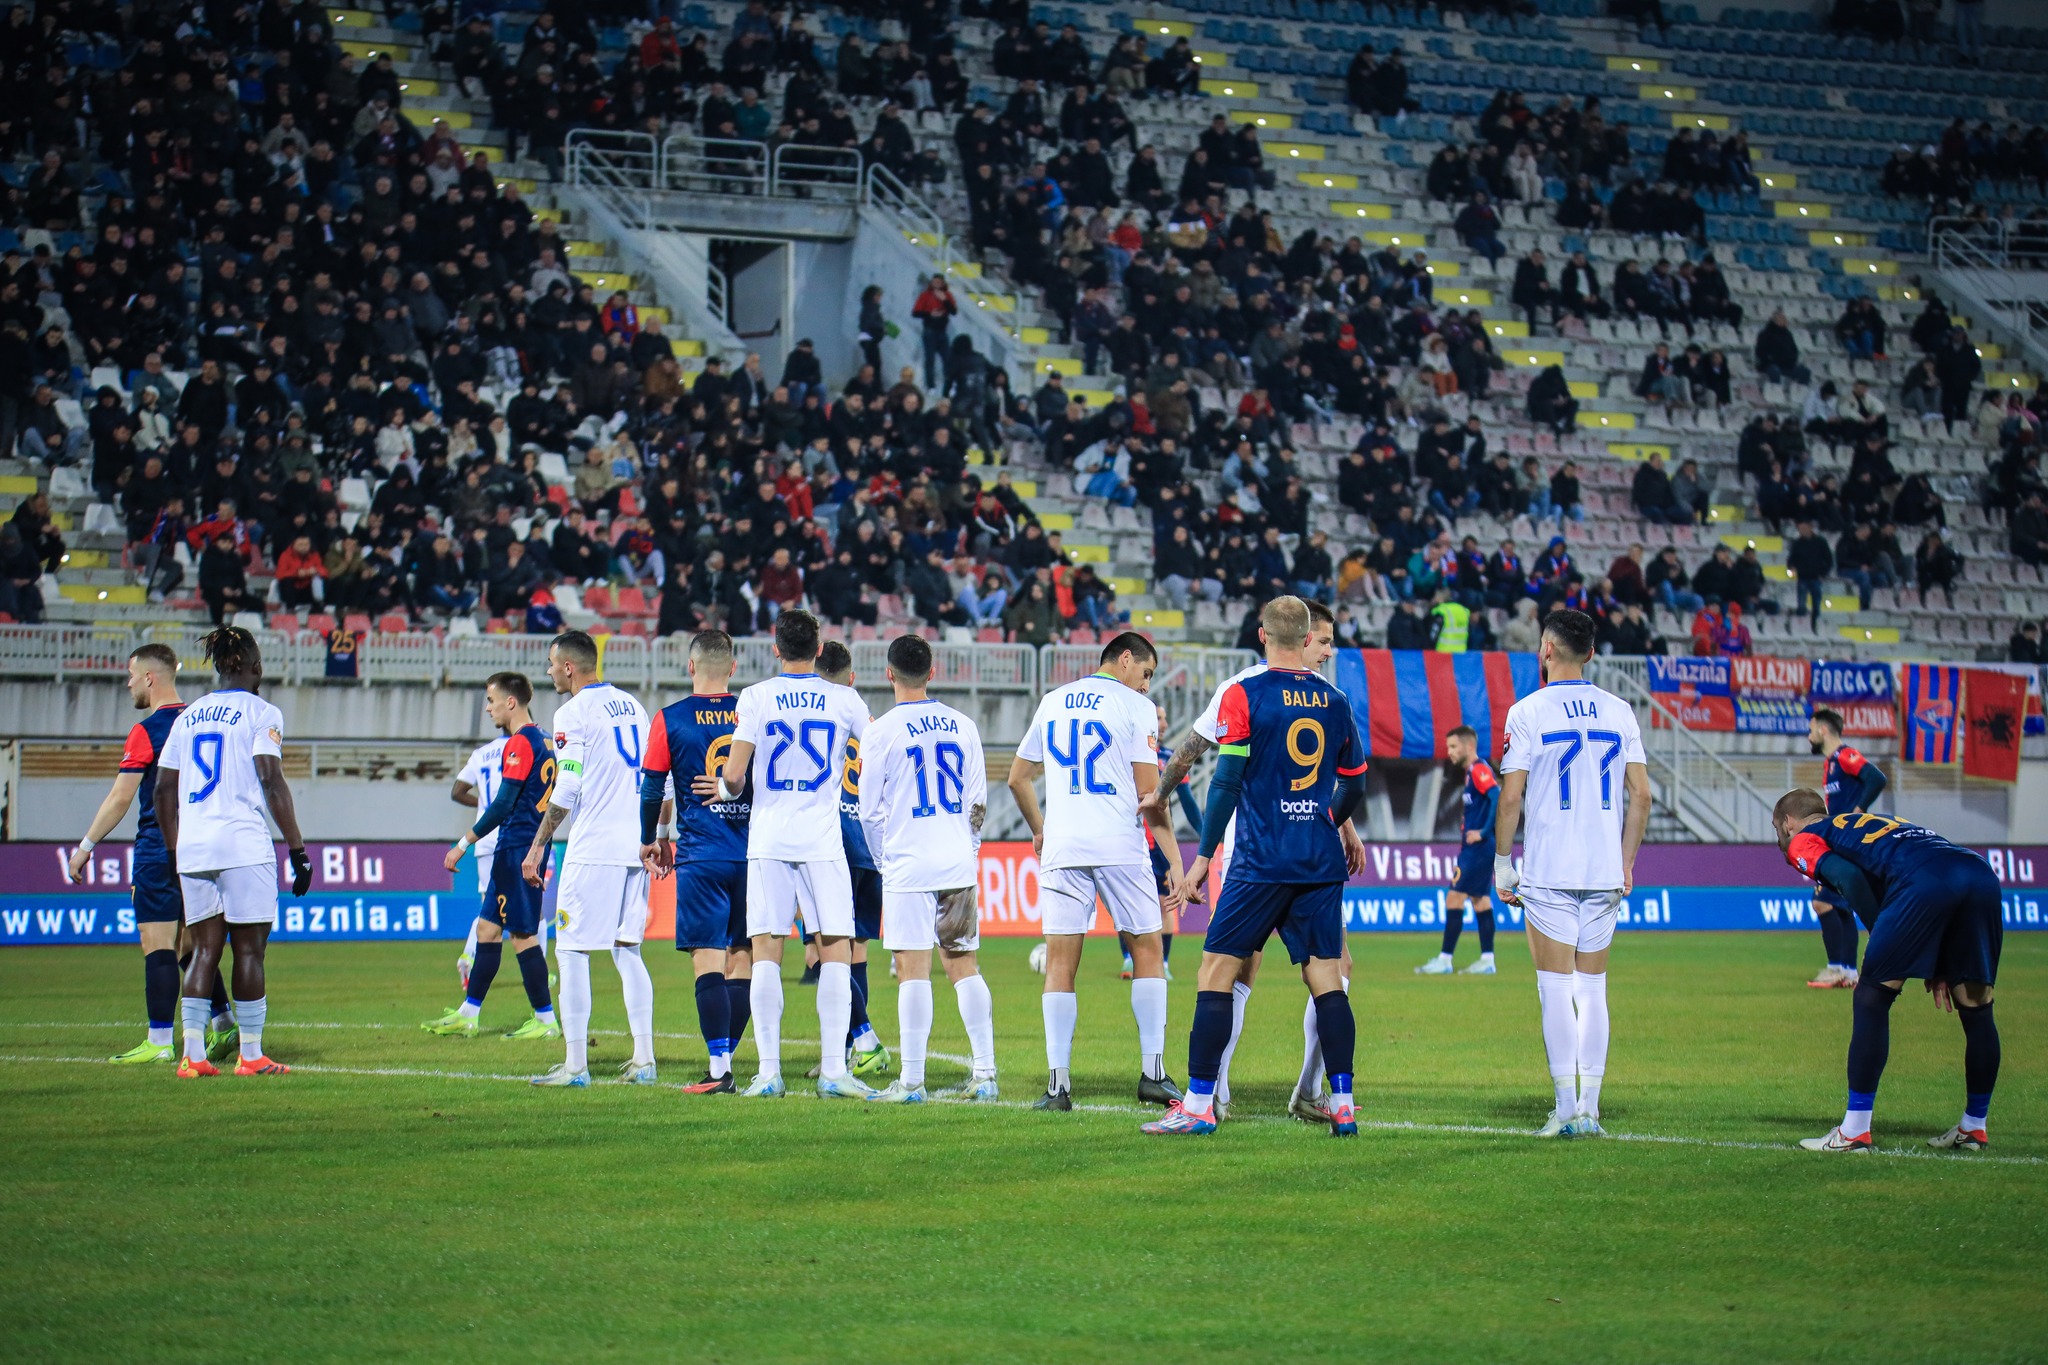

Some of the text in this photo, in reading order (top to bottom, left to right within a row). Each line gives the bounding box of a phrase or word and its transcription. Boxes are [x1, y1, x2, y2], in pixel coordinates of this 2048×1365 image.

[330, 630, 356, 654] 25
[1812, 668, 1868, 694] FORCA
[603, 700, 636, 718] LULAJ
[775, 691, 826, 711] MUSTA
[1065, 691, 1105, 710] QOSE
[1282, 689, 1328, 708] BALAJ
[1562, 700, 1598, 719] LILA
[184, 705, 242, 728] TSAGUE.B
[695, 710, 736, 725] KRYM
[906, 715, 959, 738] A.KASA
[482, 747, 501, 763] IBRA
[613, 724, 641, 794] 4
[765, 718, 837, 792] 29
[1047, 718, 1117, 795] 42
[1286, 717, 1325, 791] 9
[188, 731, 224, 804] 9
[906, 741, 965, 818] 18
[1541, 729, 1622, 810] 77
[322, 845, 384, 884] Blu
[1987, 848, 2035, 883] Blu
